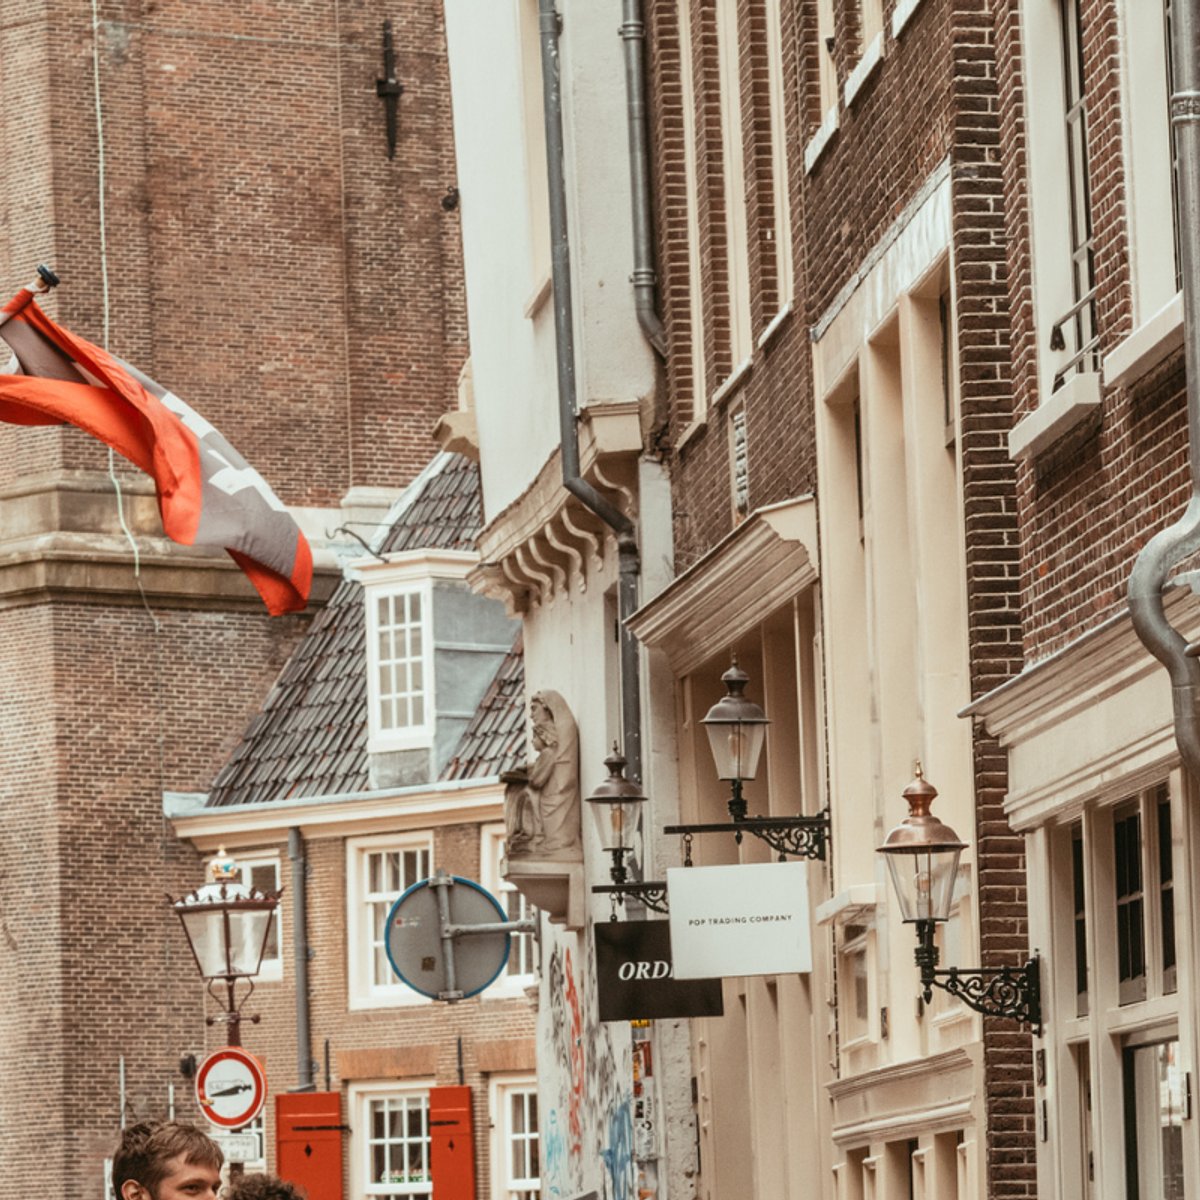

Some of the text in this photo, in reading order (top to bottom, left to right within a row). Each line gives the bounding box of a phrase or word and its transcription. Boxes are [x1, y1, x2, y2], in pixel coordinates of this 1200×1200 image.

[708, 916, 747, 925] TRADING
[749, 914, 792, 923] COMPANY
[618, 960, 674, 981] ORD
